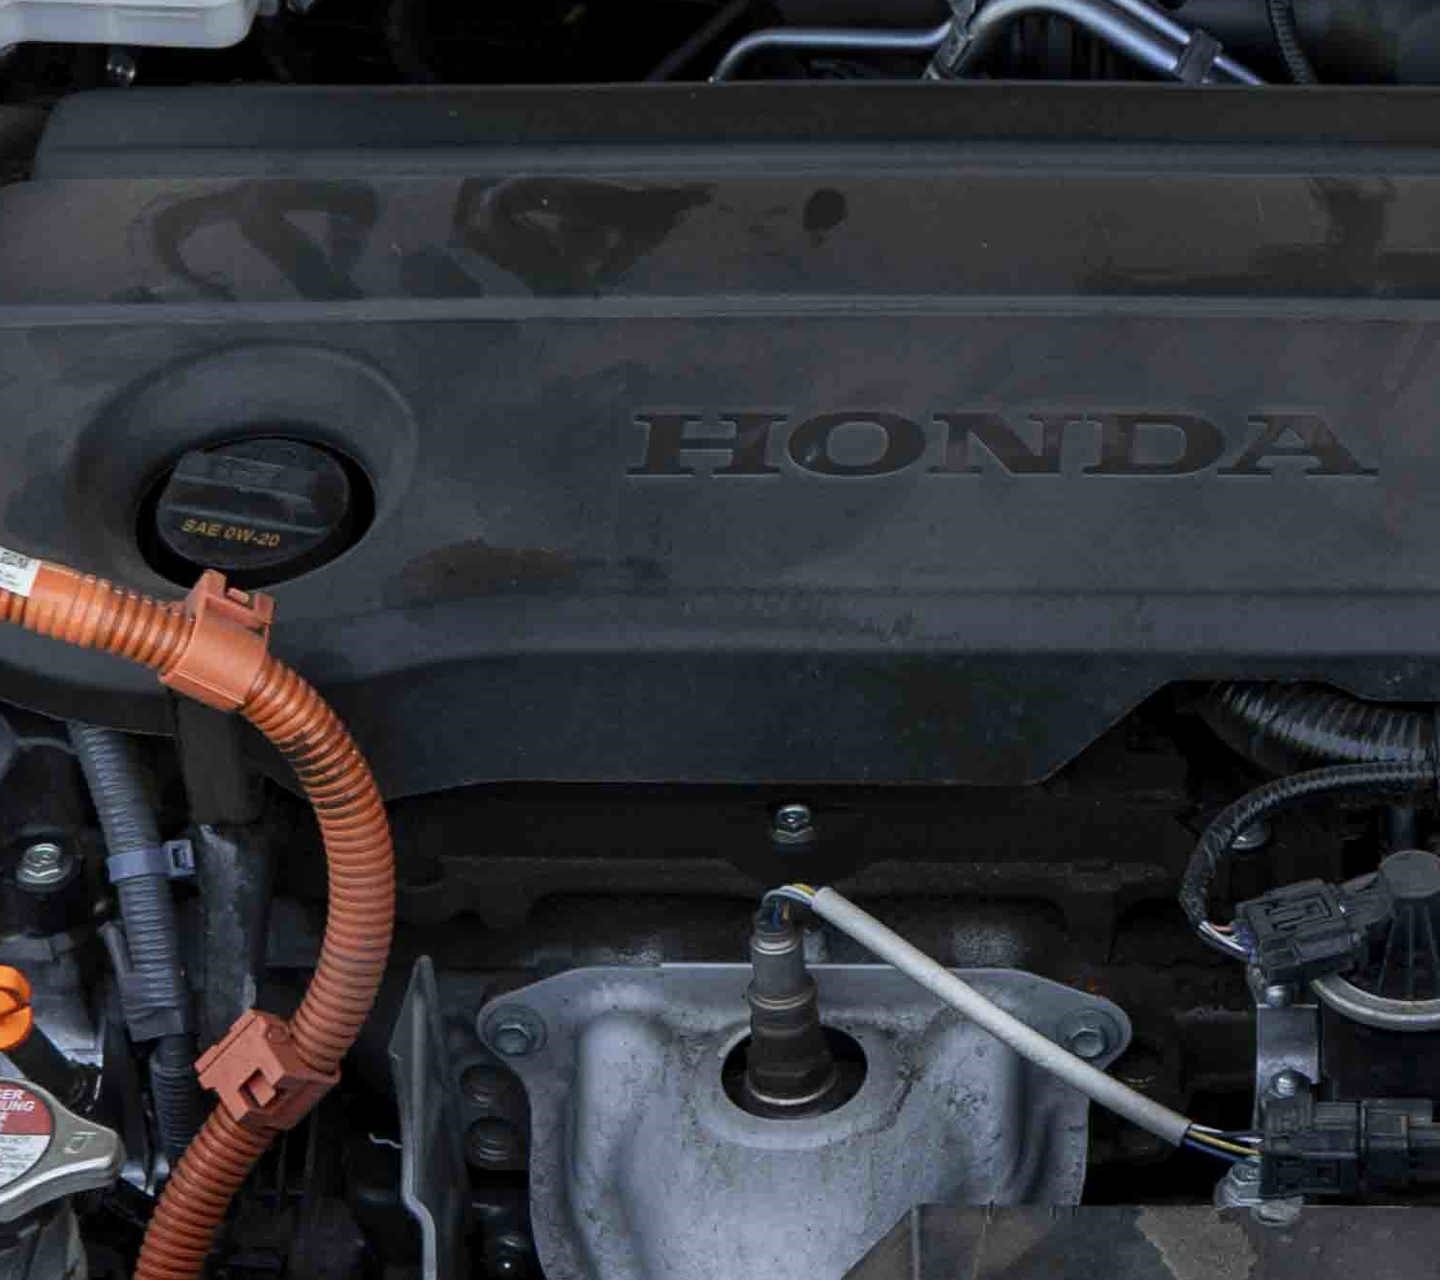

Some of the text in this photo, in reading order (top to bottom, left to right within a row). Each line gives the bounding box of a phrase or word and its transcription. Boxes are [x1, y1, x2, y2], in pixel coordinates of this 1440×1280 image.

[625, 410, 1379, 478] HONDA
[181, 519, 281, 548] SAE 0W-20
